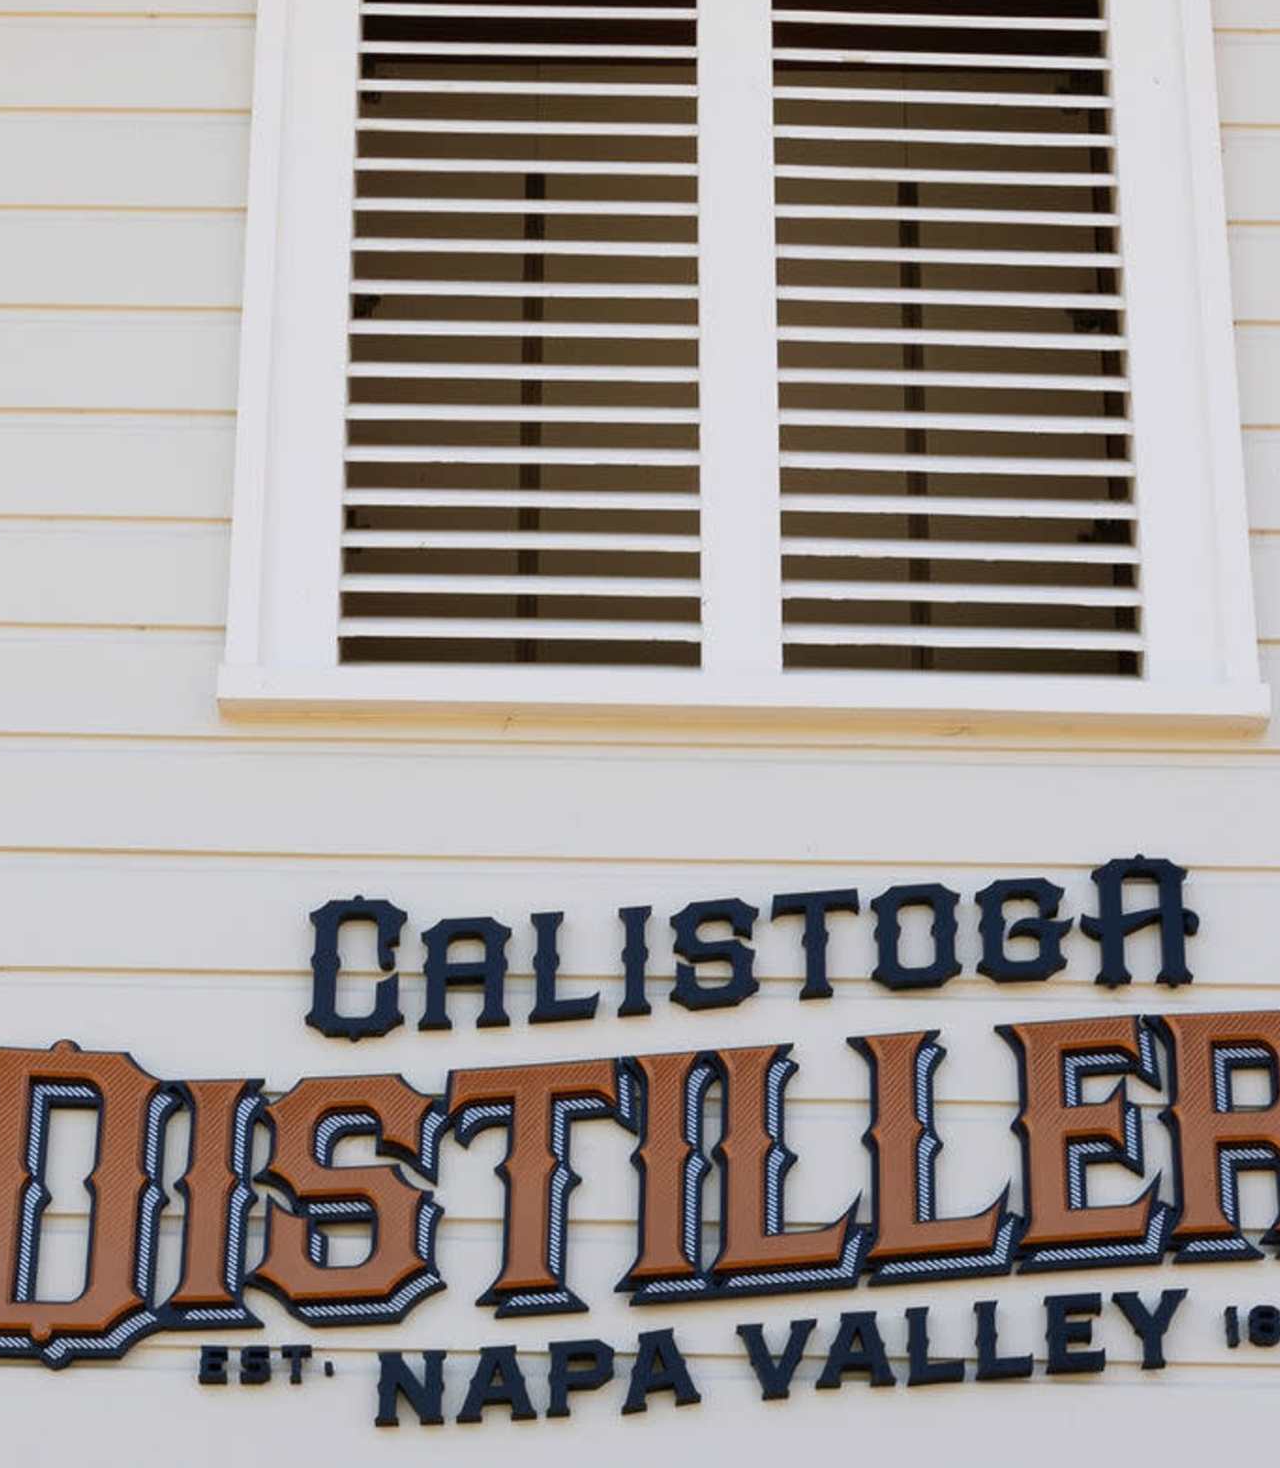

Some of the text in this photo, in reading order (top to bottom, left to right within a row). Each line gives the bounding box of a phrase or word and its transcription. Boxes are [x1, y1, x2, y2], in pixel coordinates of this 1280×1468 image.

[305, 854, 1200, 1043] CALISTOGA
[198, 1344, 335, 1387] EST.
[374, 1328, 702, 1428] NAPA
[736, 1288, 1189, 1401] VALLEY
